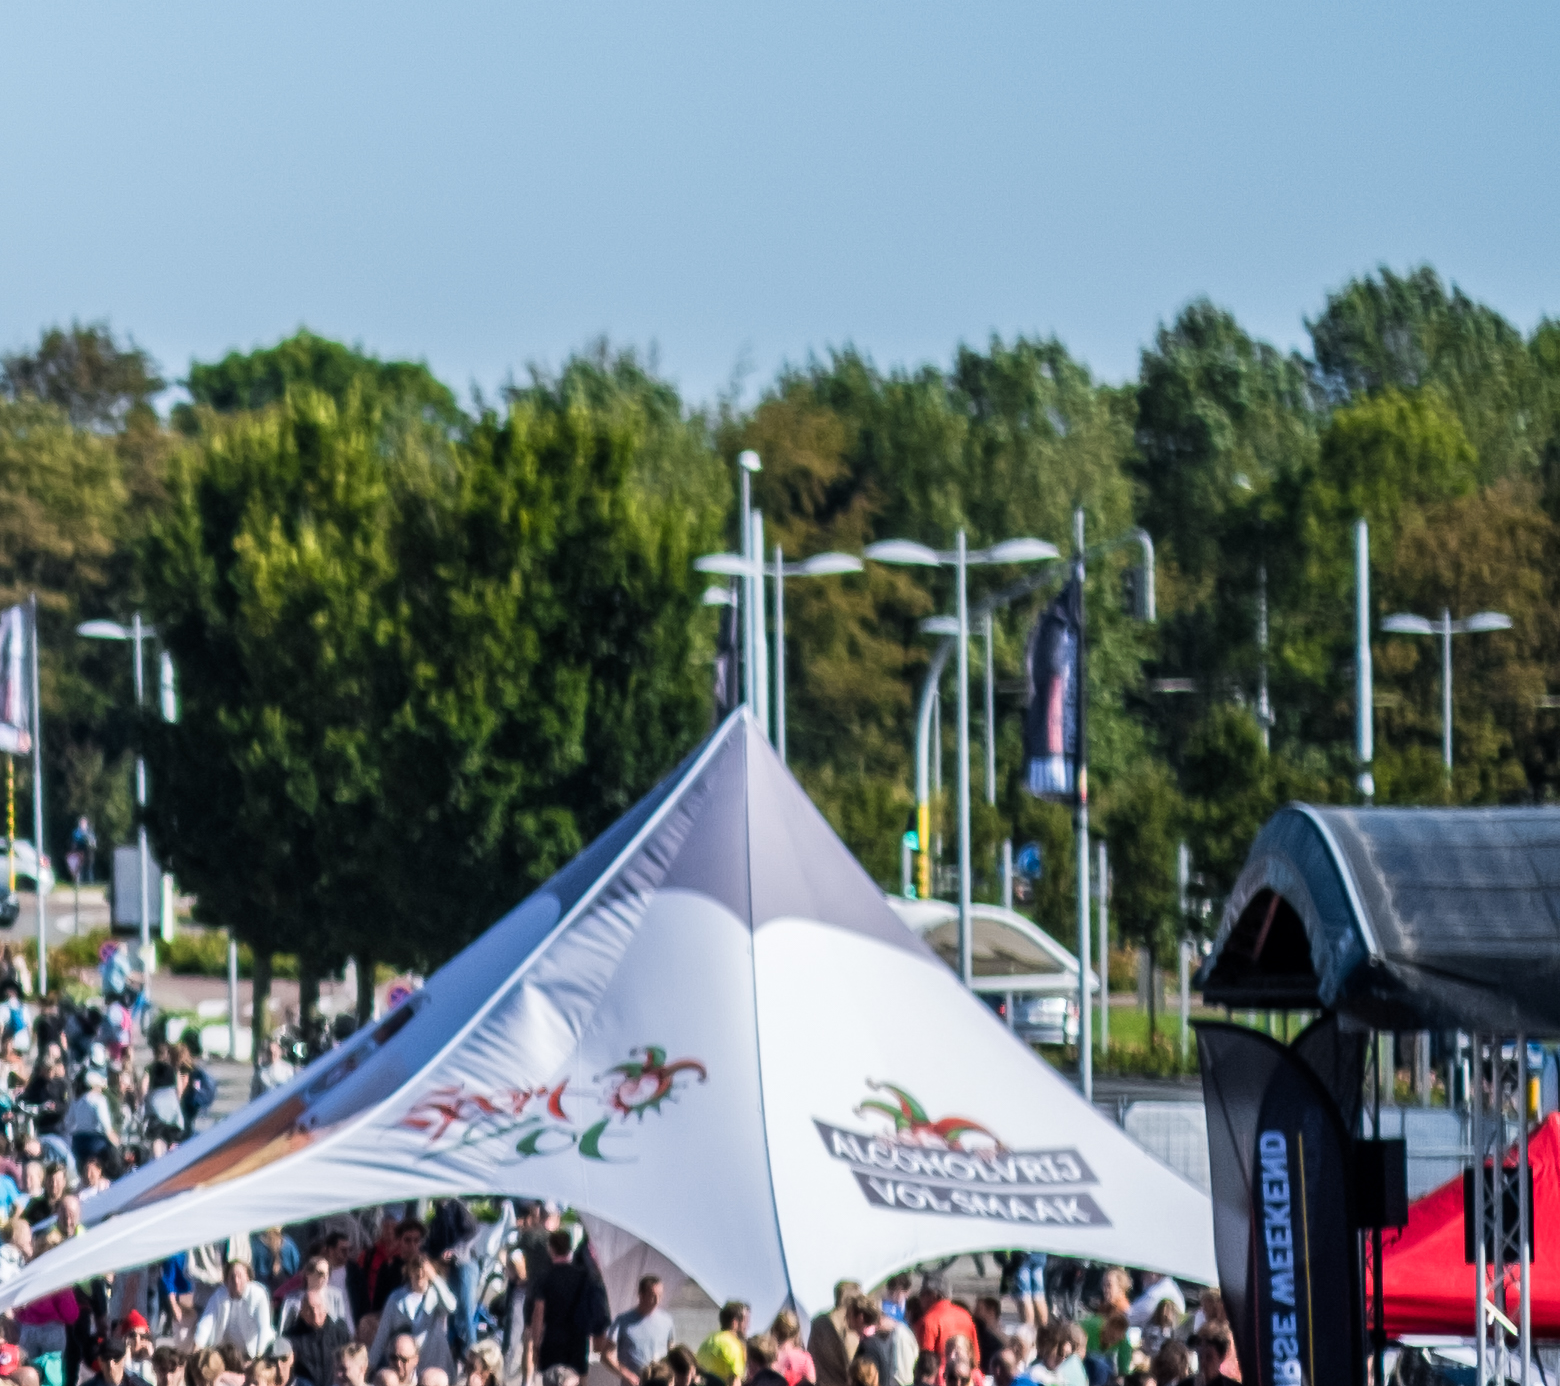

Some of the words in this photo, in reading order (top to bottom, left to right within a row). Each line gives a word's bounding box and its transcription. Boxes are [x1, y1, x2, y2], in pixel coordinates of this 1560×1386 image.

[831, 1129, 1082, 1183] ALCOHOLVRIJ
[869, 1177, 951, 1213] VOL
[951, 1190, 1091, 1224] SMAAK
